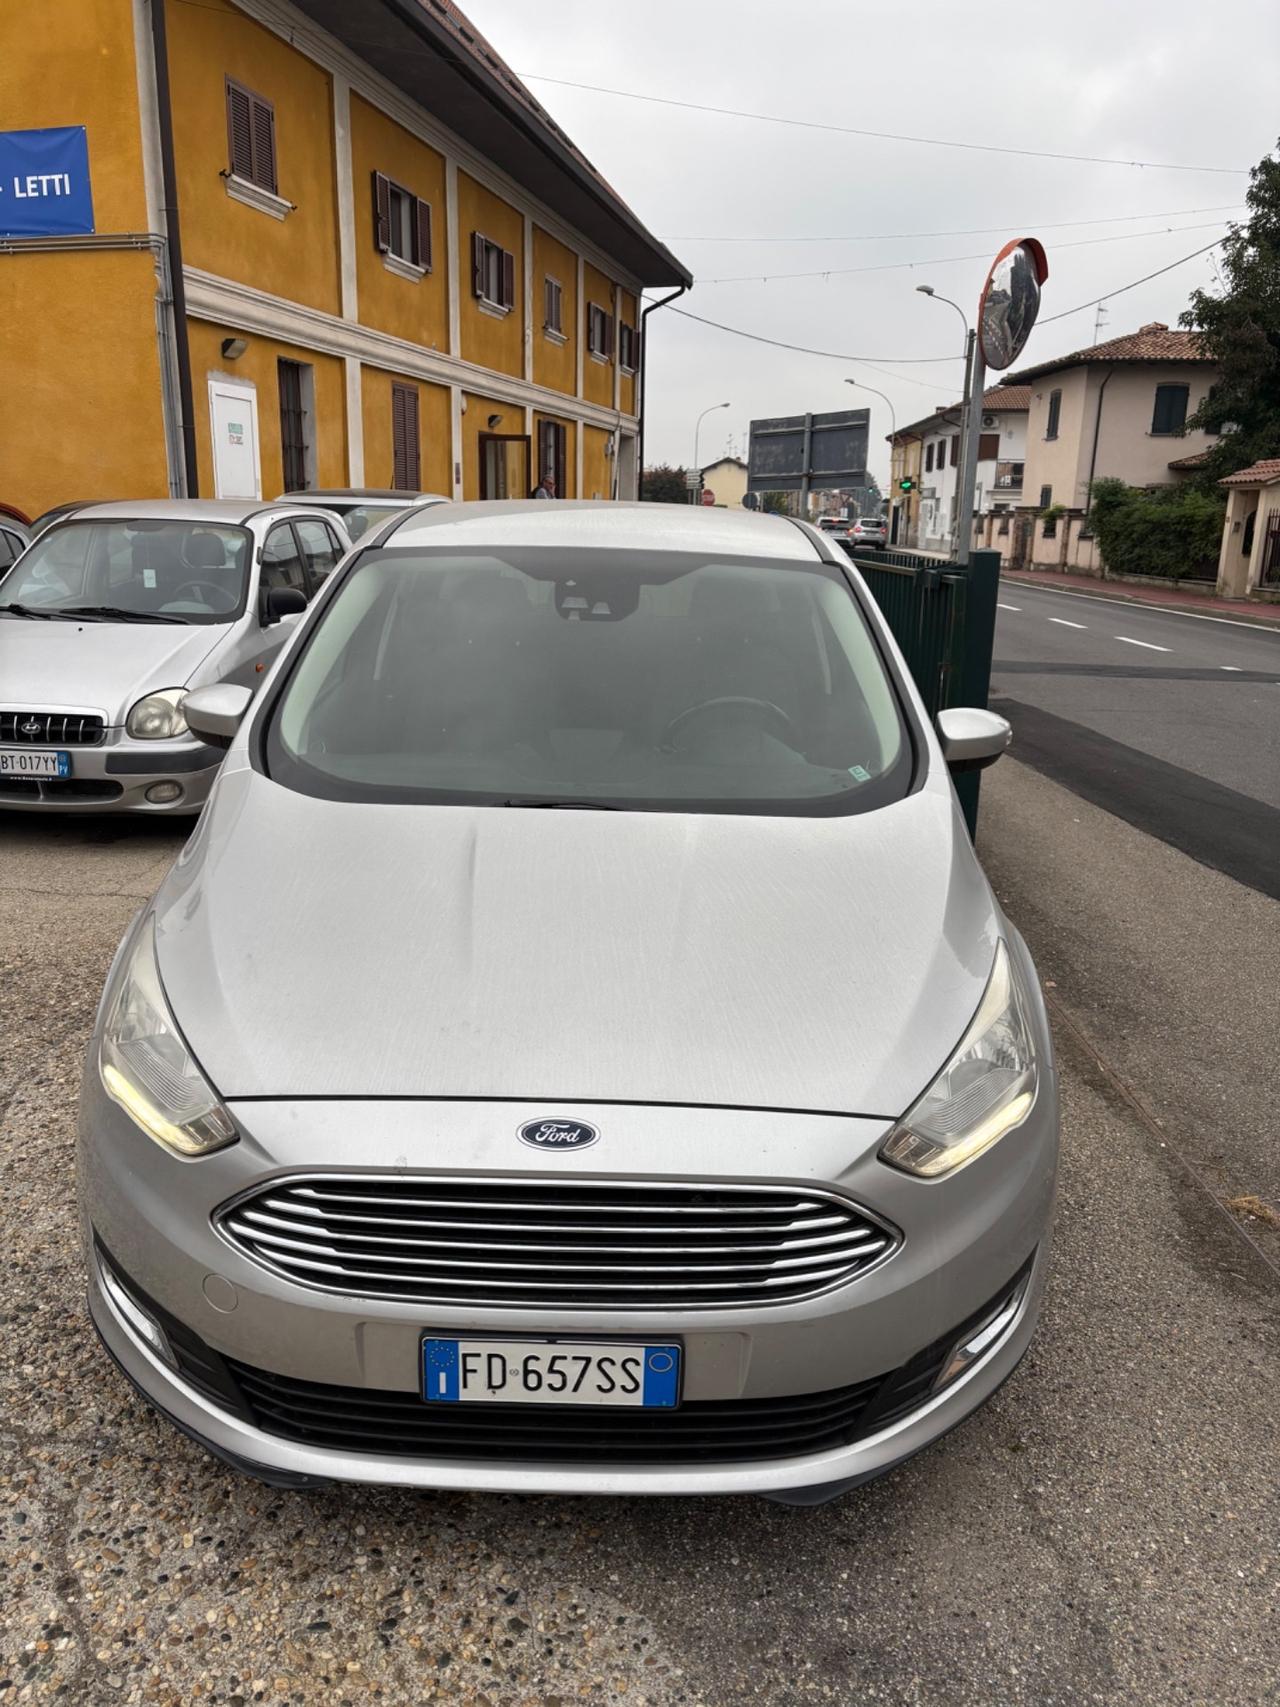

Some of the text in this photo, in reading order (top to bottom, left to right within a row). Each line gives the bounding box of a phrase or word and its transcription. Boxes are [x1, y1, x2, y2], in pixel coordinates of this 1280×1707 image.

[13, 173, 71, 198] LETTI
[0, 755, 57, 771] BT 017YY
[535, 1123, 581, 1142] Ford
[461, 1352, 642, 1394] FD 657SS
